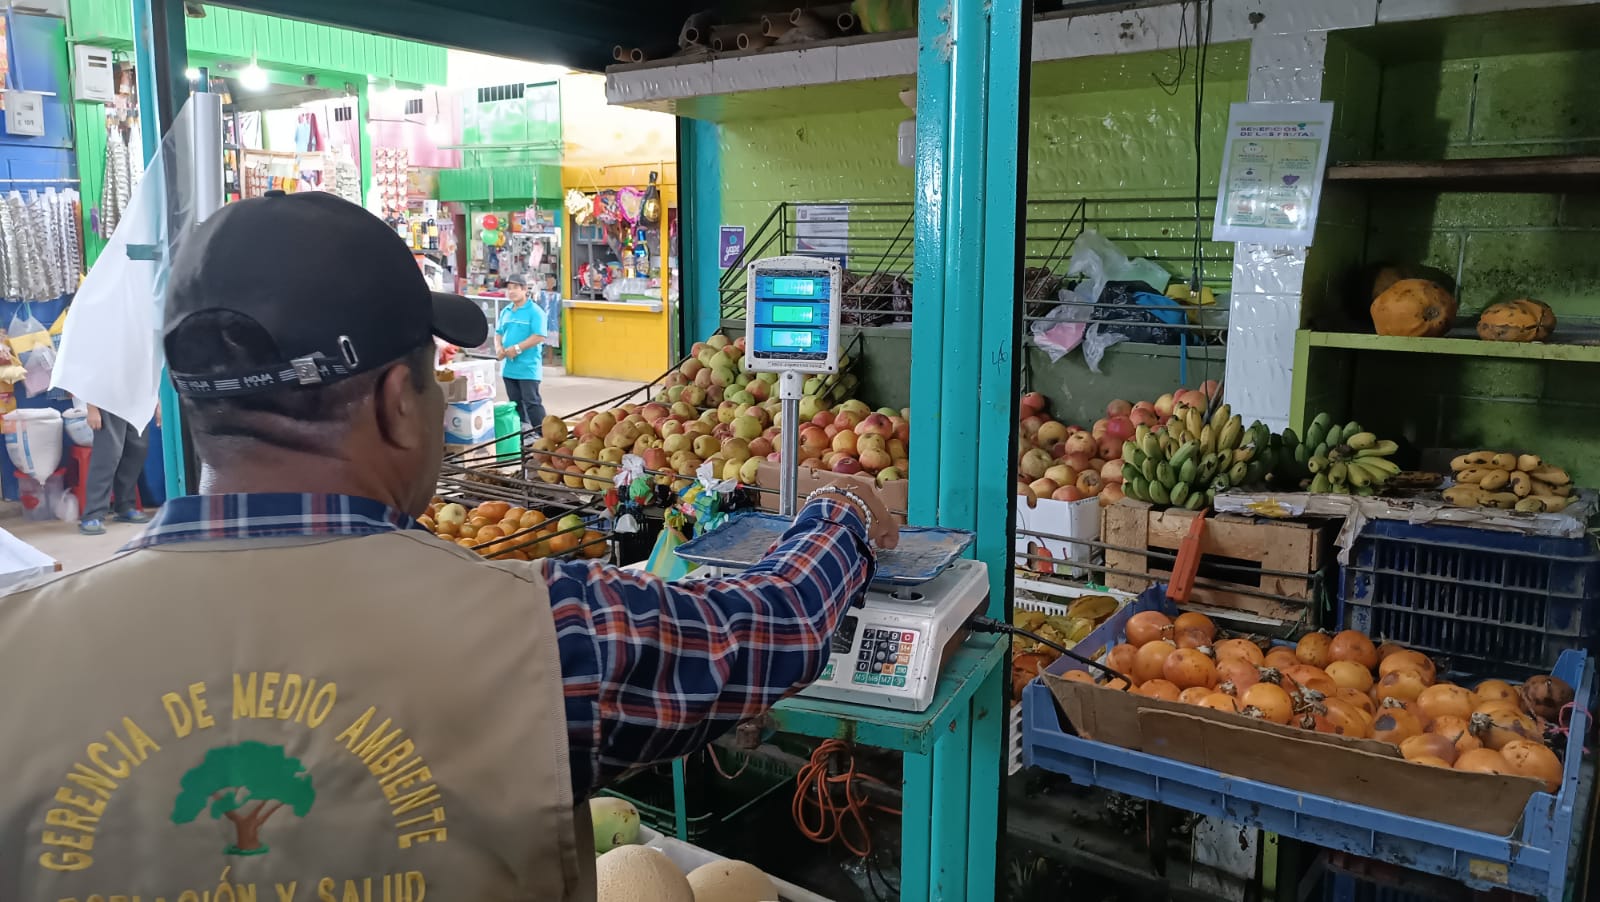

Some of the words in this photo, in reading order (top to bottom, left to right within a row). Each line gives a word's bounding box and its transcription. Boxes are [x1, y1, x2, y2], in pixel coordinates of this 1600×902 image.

[891, 632, 898, 640] 9
[864, 641, 870, 649] 4
[889, 643, 896, 651] 6
[859, 662, 866, 670] 0
[39, 716, 161, 872] GERENCIA
[161, 681, 215, 738] DE
[232, 671, 337, 728] MEDIO
[335, 706, 447, 849] AMBIENTE
